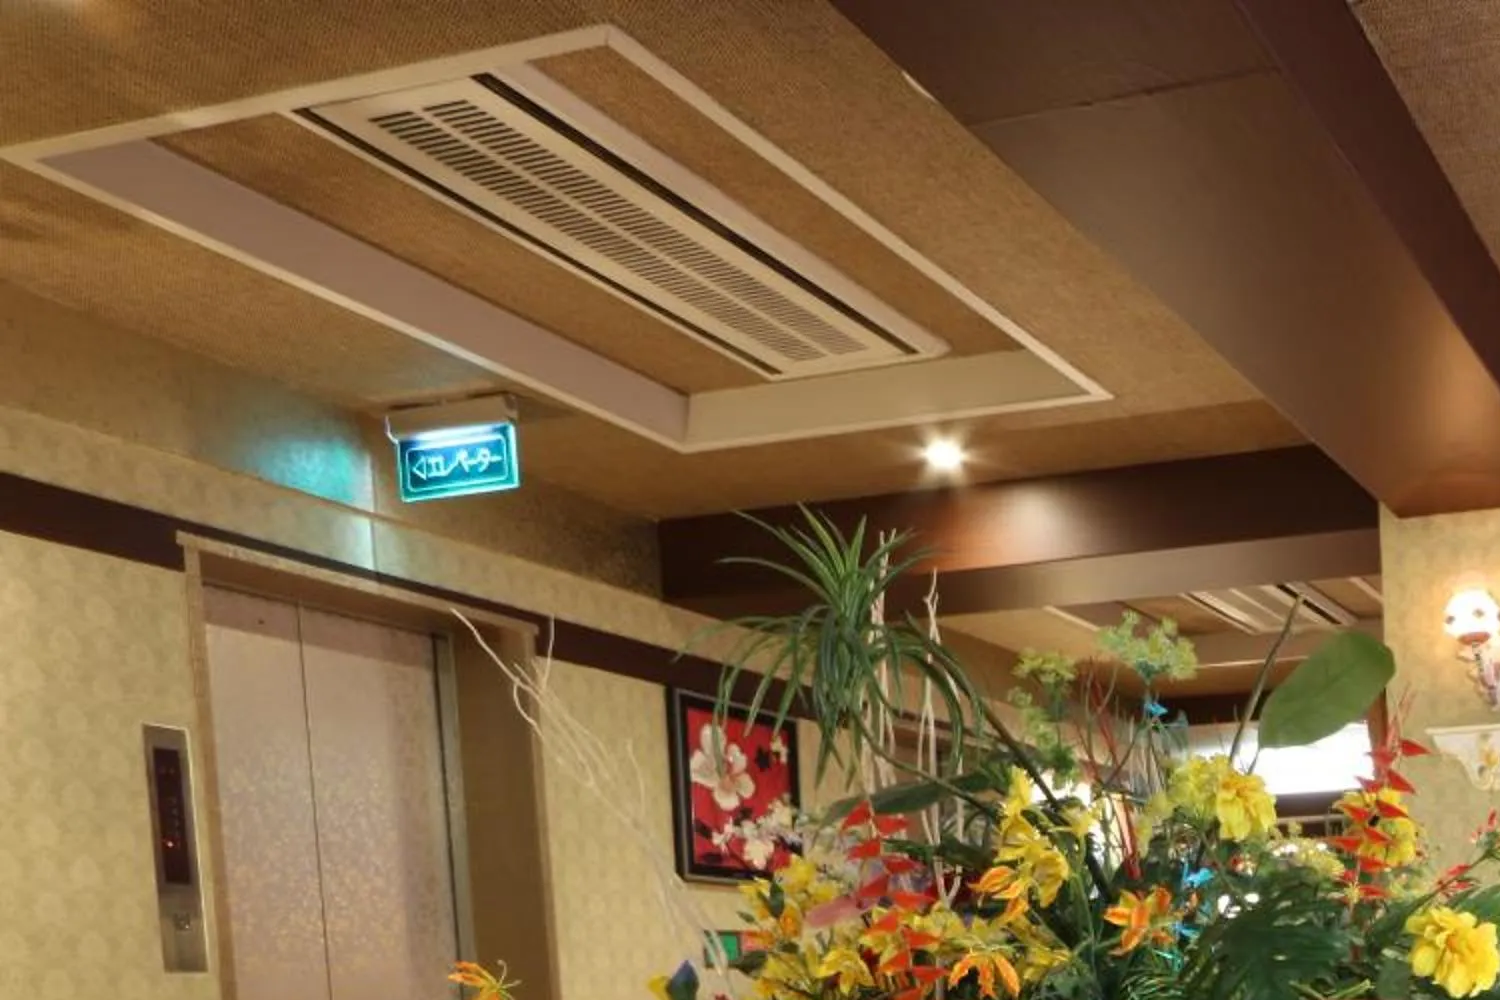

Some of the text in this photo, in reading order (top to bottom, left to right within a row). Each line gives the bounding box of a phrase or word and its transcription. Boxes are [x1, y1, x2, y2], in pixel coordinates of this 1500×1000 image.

[426, 446, 504, 478] エレベーター
